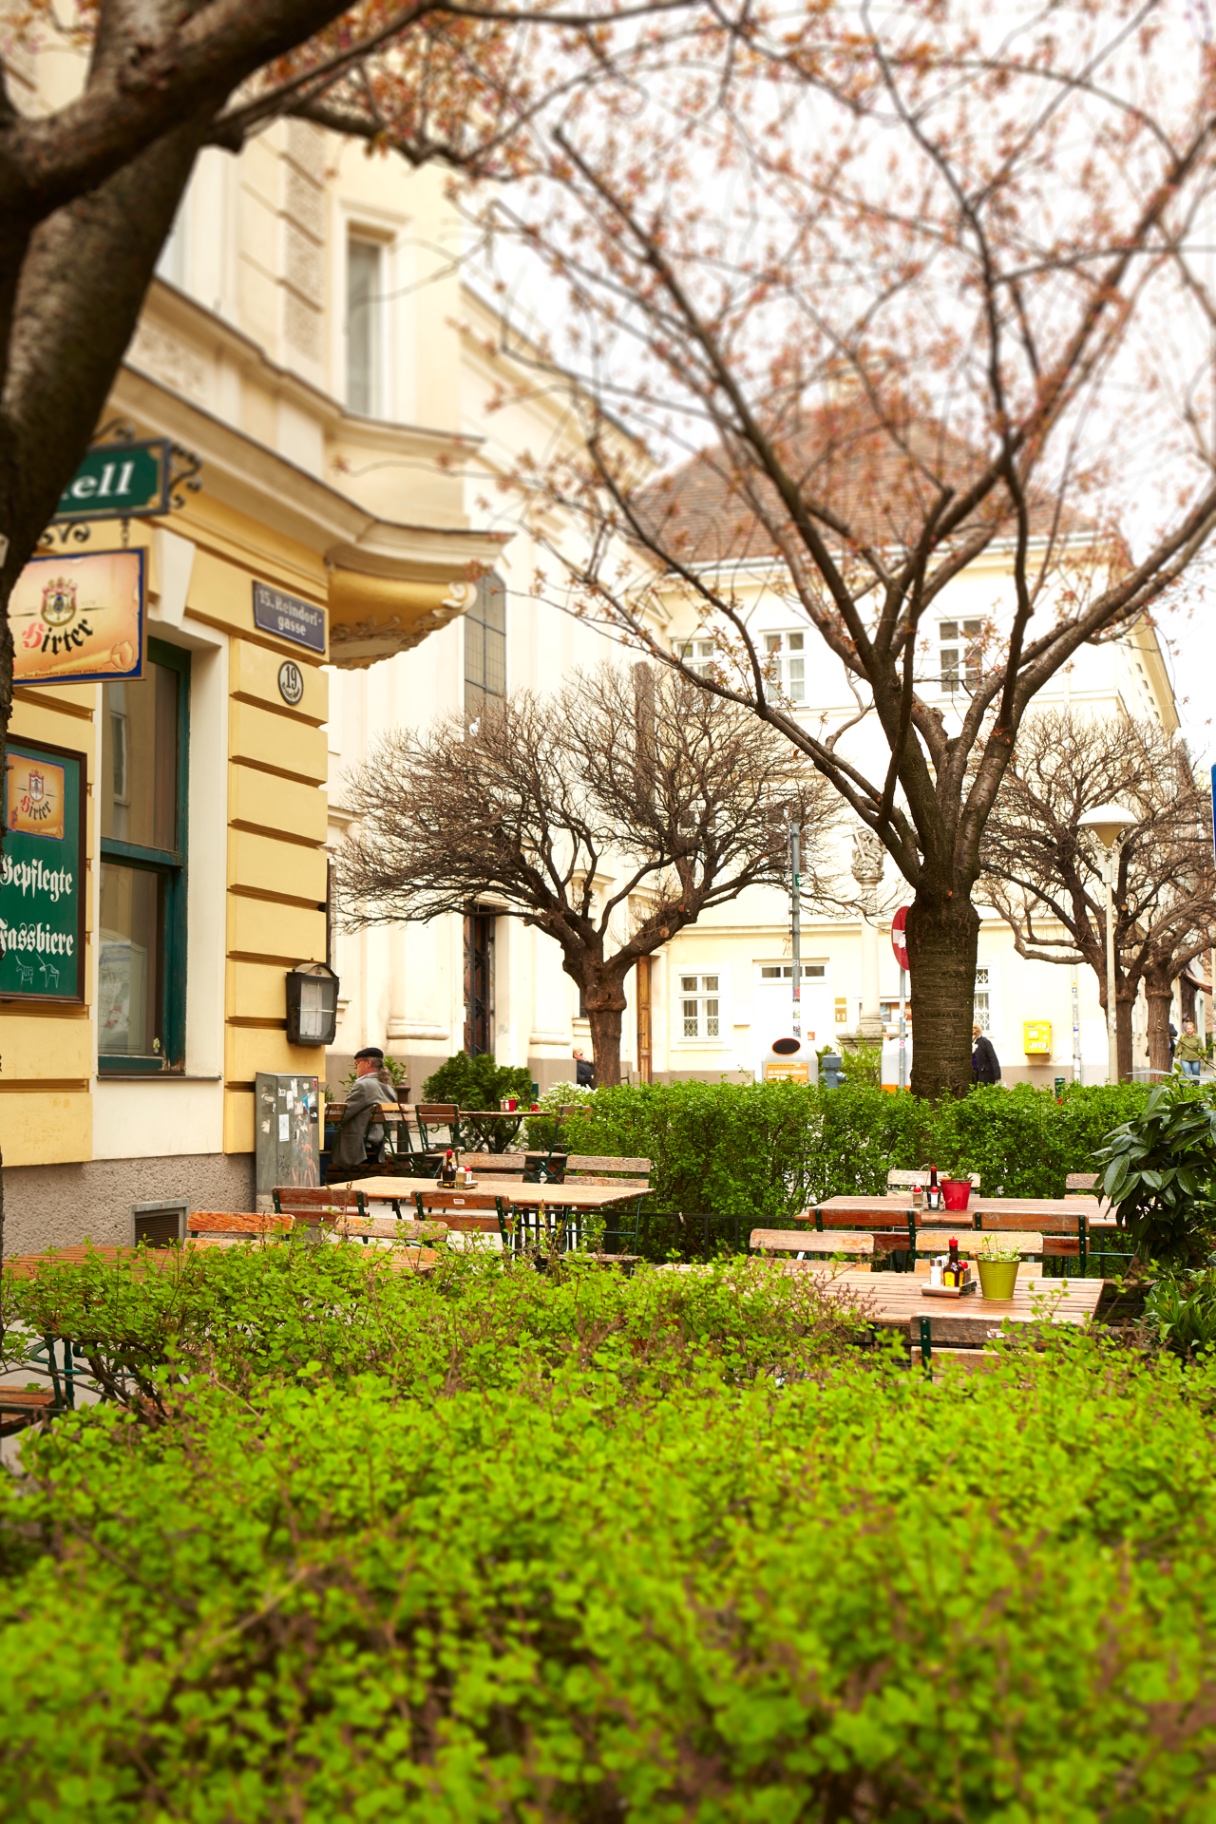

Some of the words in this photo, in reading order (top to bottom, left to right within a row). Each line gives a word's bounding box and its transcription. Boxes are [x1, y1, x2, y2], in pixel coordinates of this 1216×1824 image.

[64, 460, 135, 499] ell
[277, 616, 307, 636] gasse
[285, 665, 298, 690] 19
